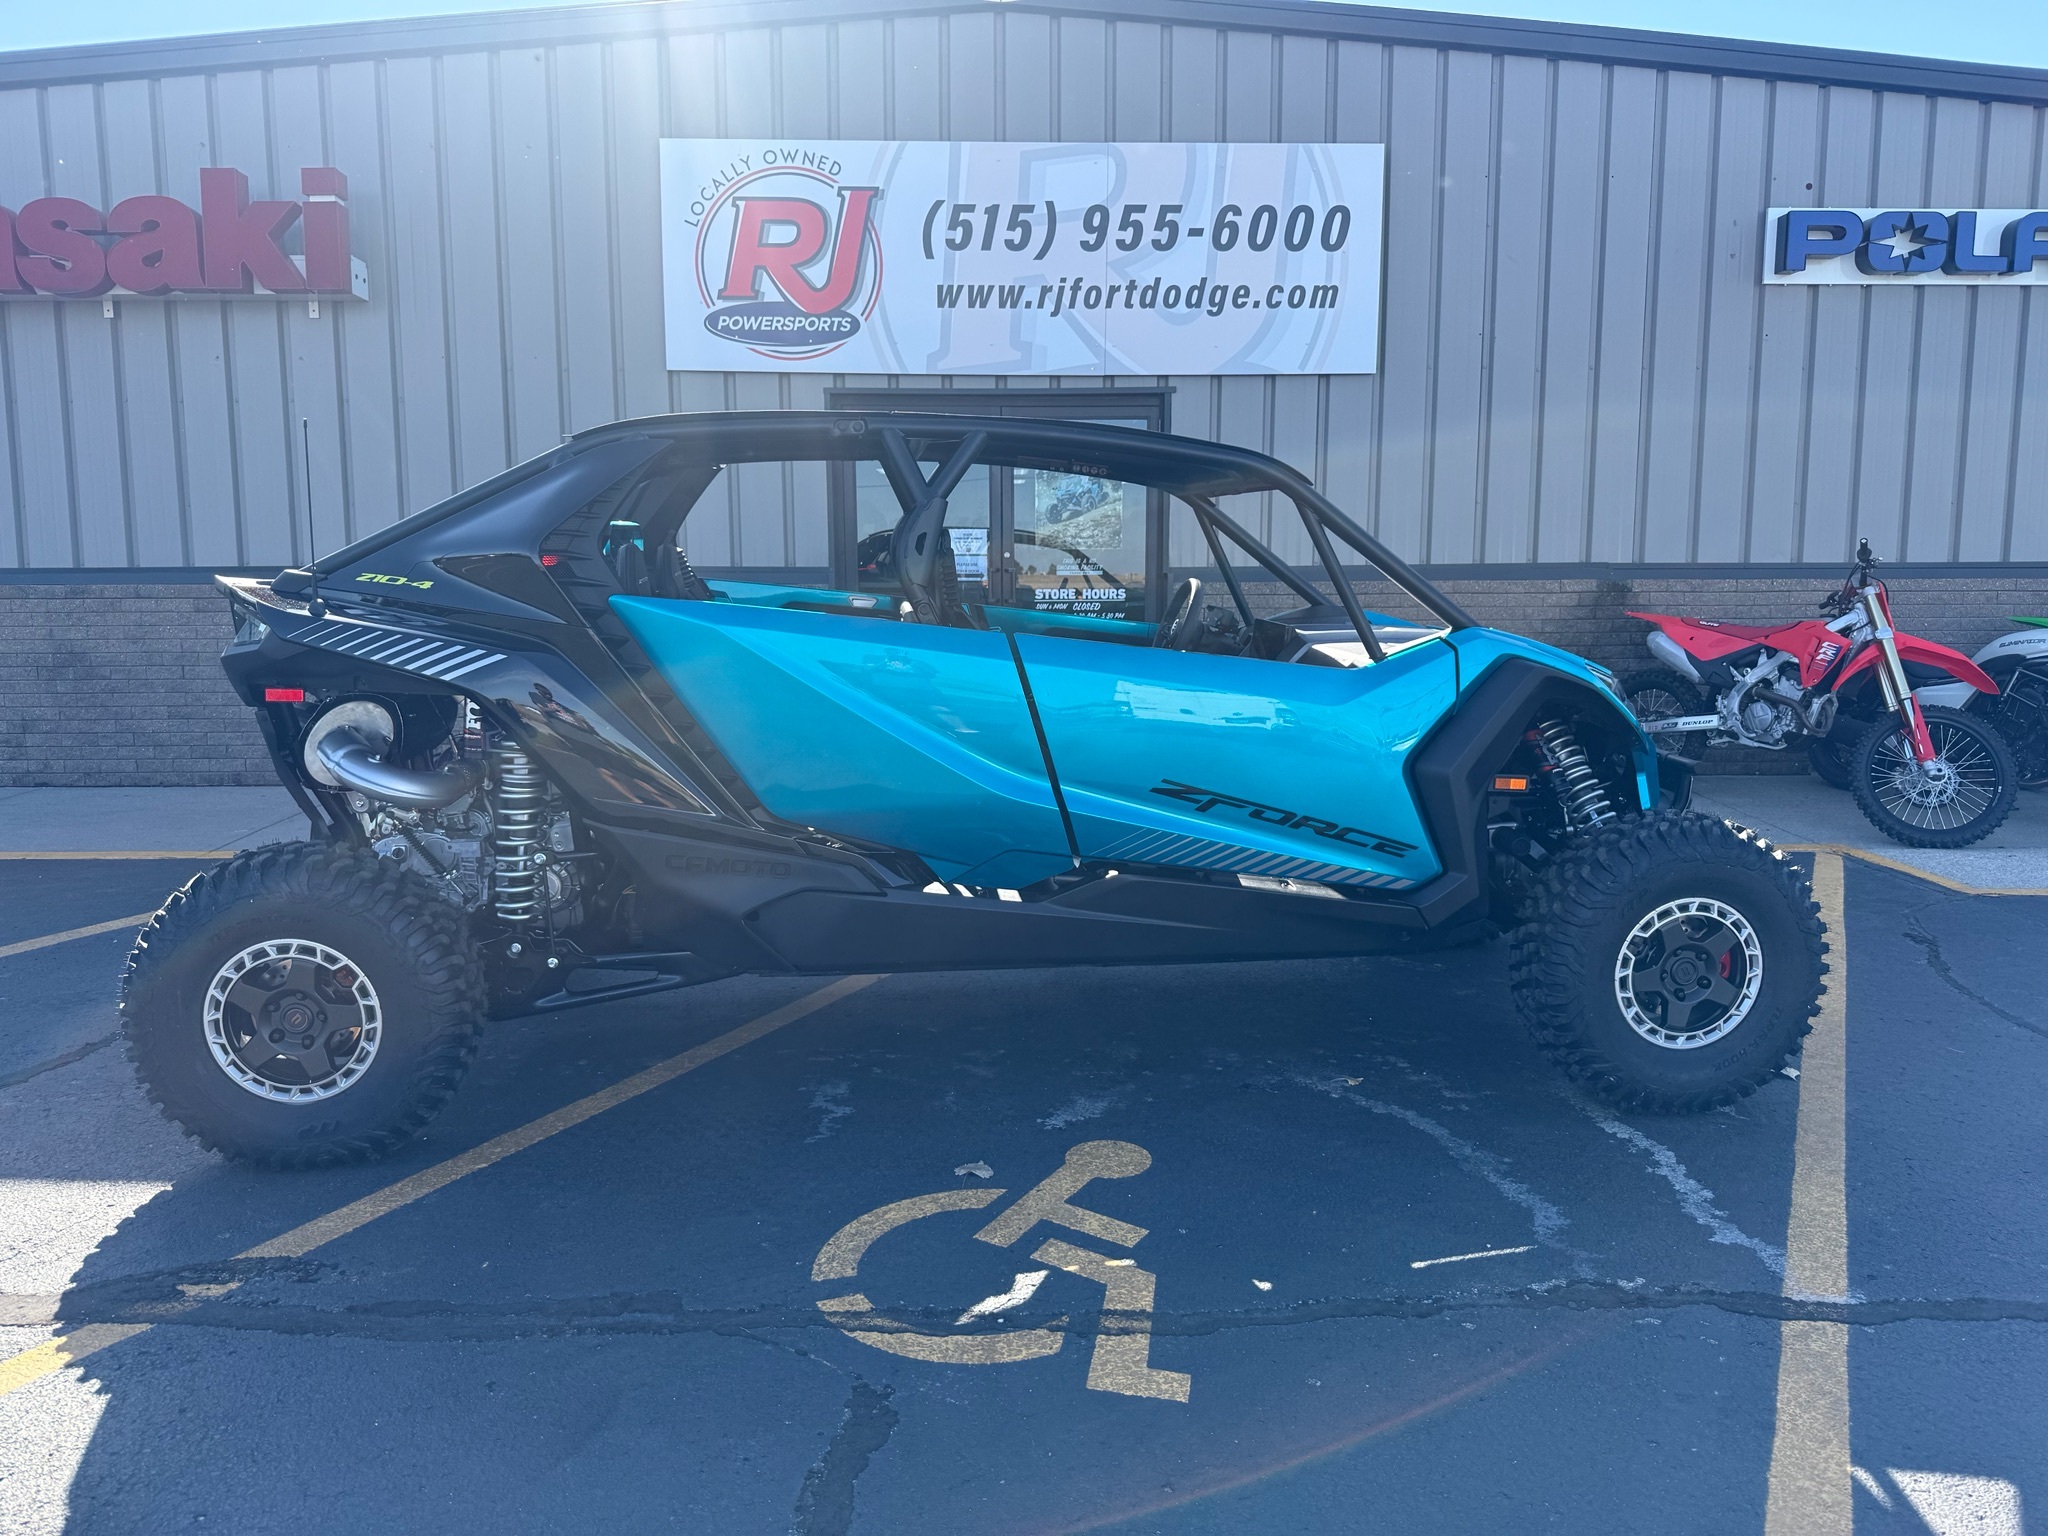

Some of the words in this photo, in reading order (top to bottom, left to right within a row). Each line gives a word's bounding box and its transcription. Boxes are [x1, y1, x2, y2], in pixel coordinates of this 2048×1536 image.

[684, 154, 752, 228] LOCALLY
[762, 148, 842, 177] OWNED
[0, 168, 348, 297] saki
[922, 199, 1057, 260] (515)
[1080, 203, 1352, 254] 955-6000
[716, 186, 886, 315] RJ
[936, 276, 1340, 318] www.rjfortdodge.com
[717, 315, 852, 332] POWERSPORTS
[1034, 588, 1077, 600] STORE
[1082, 588, 1127, 600] HOURS
[1072, 602, 1101, 611] CLOSED
[1998, 638, 2047, 649] ELIMINATOR
[1681, 719, 1714, 727] DUNLOP
[1149, 778, 1419, 858] ZFORCE
[664, 855, 791, 880] CFMOTO
